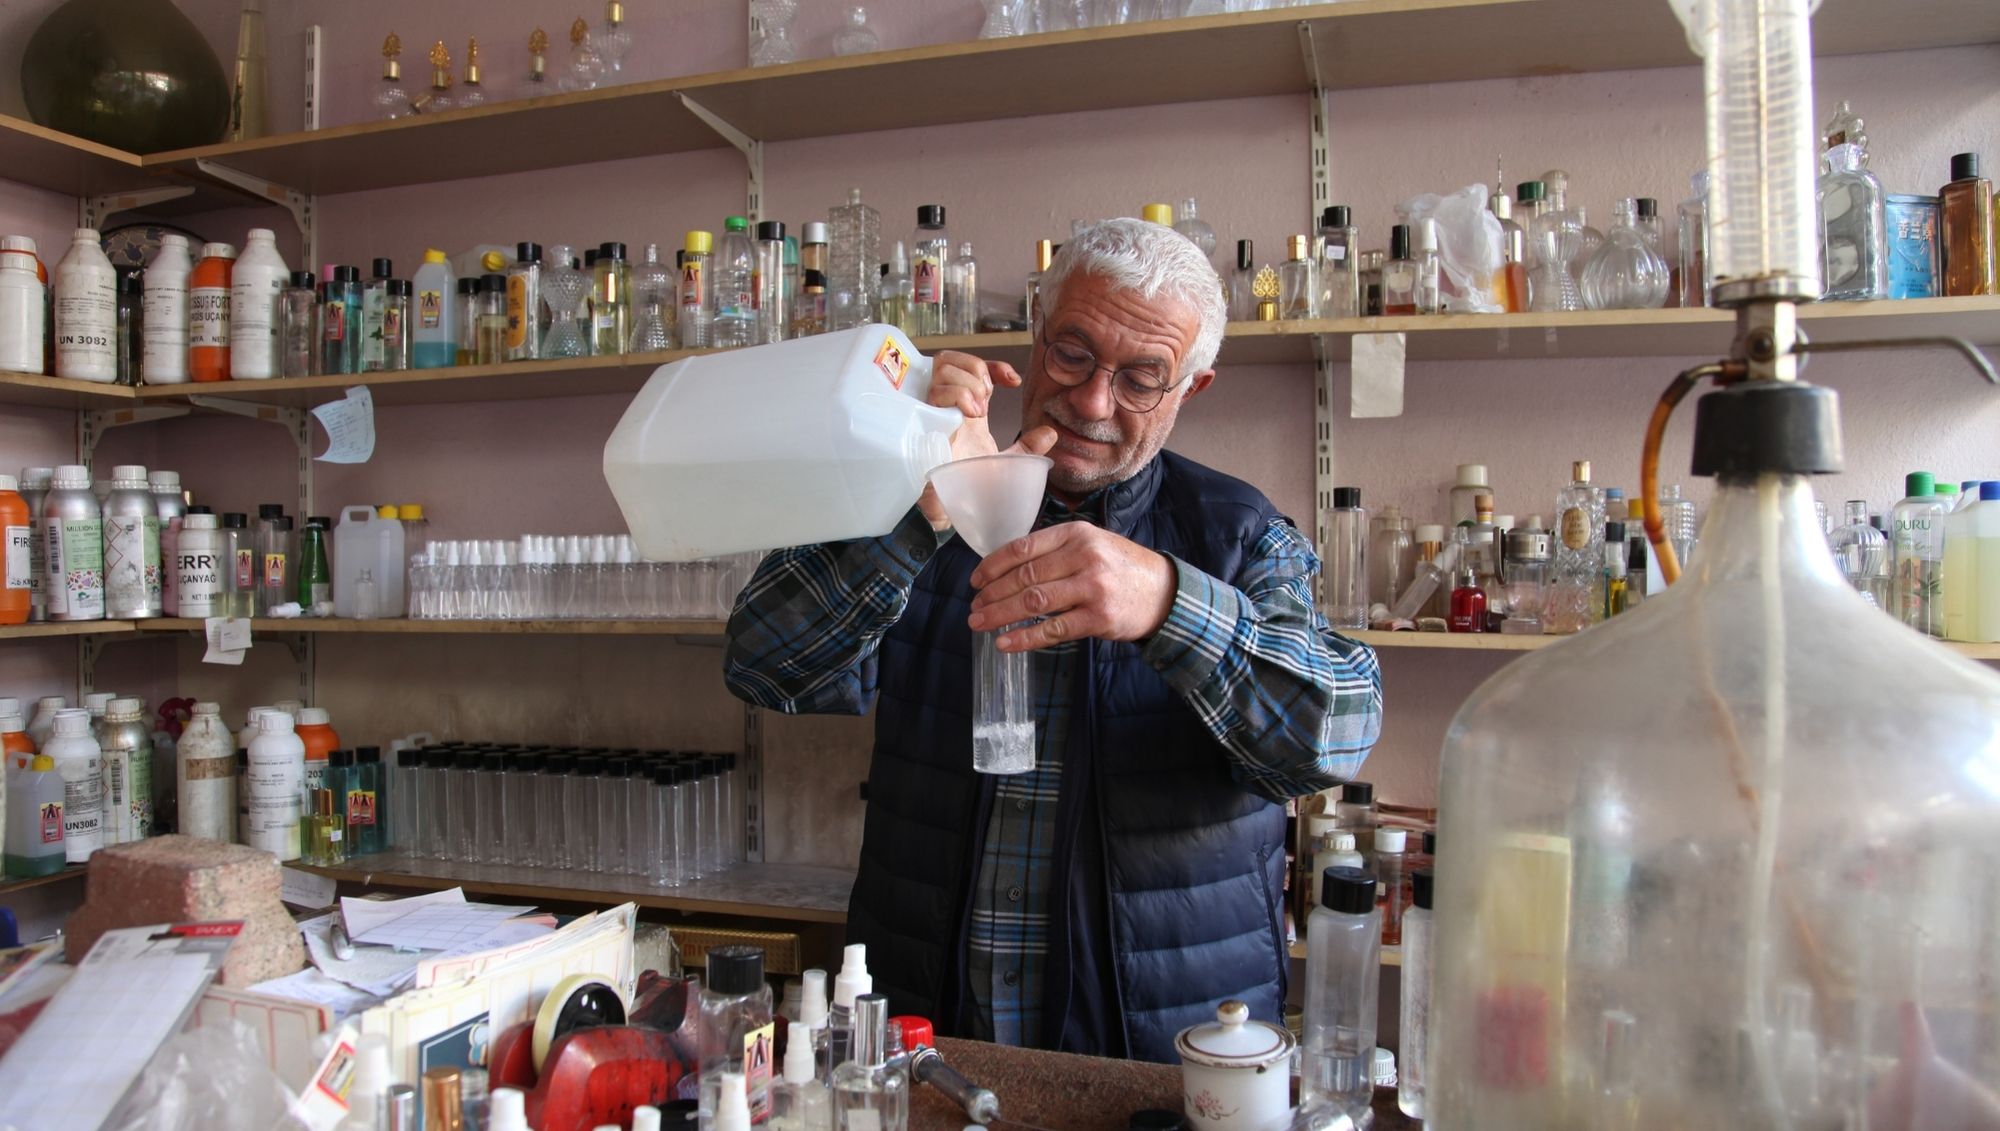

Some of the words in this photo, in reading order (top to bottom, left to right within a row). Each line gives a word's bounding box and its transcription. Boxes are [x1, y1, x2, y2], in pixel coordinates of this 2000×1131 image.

[59, 335, 74, 345] UN
[78, 335, 107, 347] 3082
[1895, 519, 1931, 531] DURU
[65, 818, 98, 831] UN3082
